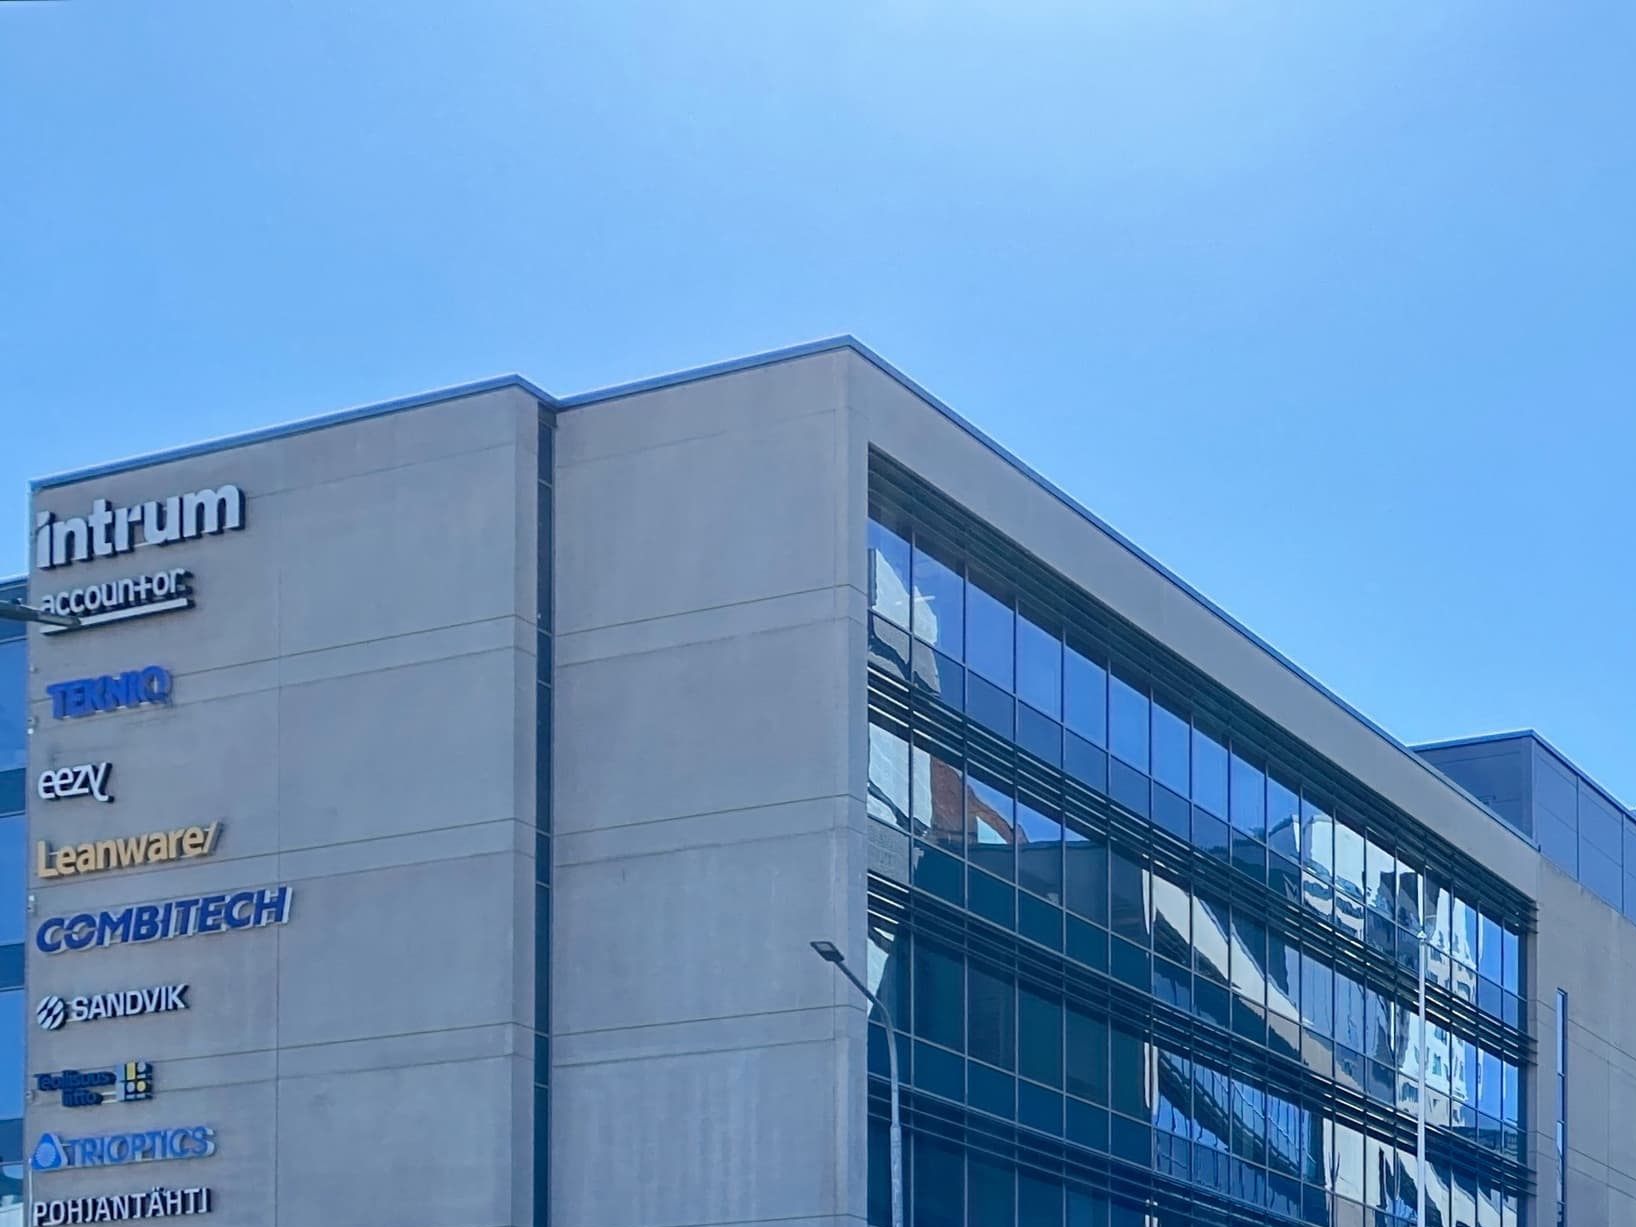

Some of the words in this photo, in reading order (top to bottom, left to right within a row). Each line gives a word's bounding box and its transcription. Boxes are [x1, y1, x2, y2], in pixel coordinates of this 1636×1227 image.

[37, 485, 242, 568] intrum
[38, 761, 112, 802] eezy
[36, 886, 292, 955] COMBITECH
[72, 984, 188, 1021] SANDVIK
[68, 1126, 213, 1168] TRIOPTICS
[33, 1187, 211, 1227] POHJANTÄHTI
